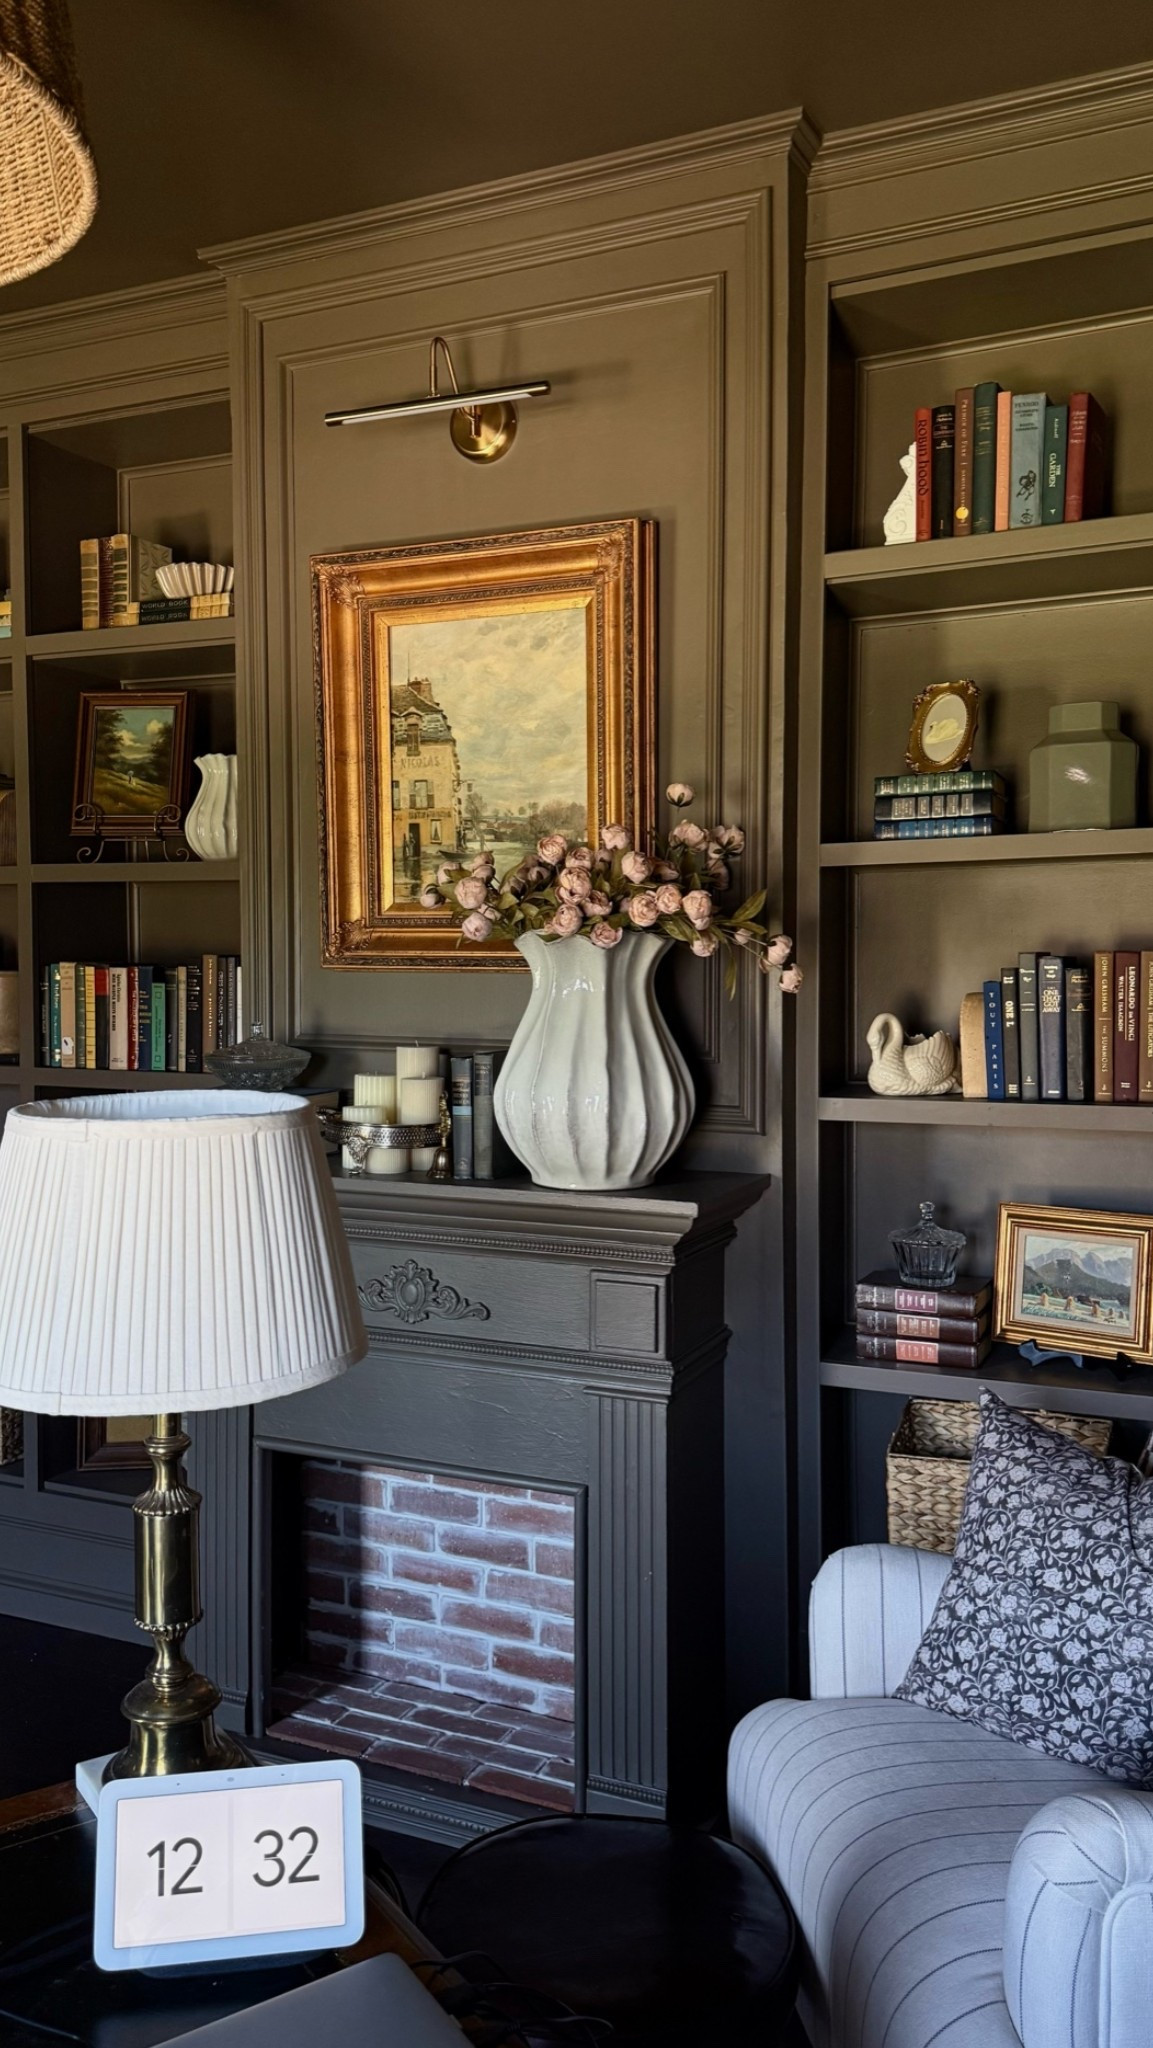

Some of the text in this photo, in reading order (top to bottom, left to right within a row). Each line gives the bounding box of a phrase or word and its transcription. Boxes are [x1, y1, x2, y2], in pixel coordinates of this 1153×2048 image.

[1048, 452, 1057, 488] GARDEN
[400, 755, 441, 769] NICOLAS
[1101, 957, 1109, 1012] JOHN GRISHAM
[1128, 966, 1136, 1009] LEONARDO
[988, 992, 996, 1028] TOUT
[1005, 1000, 1014, 1019] ONE
[146, 1825, 320, 1897] 12 32
